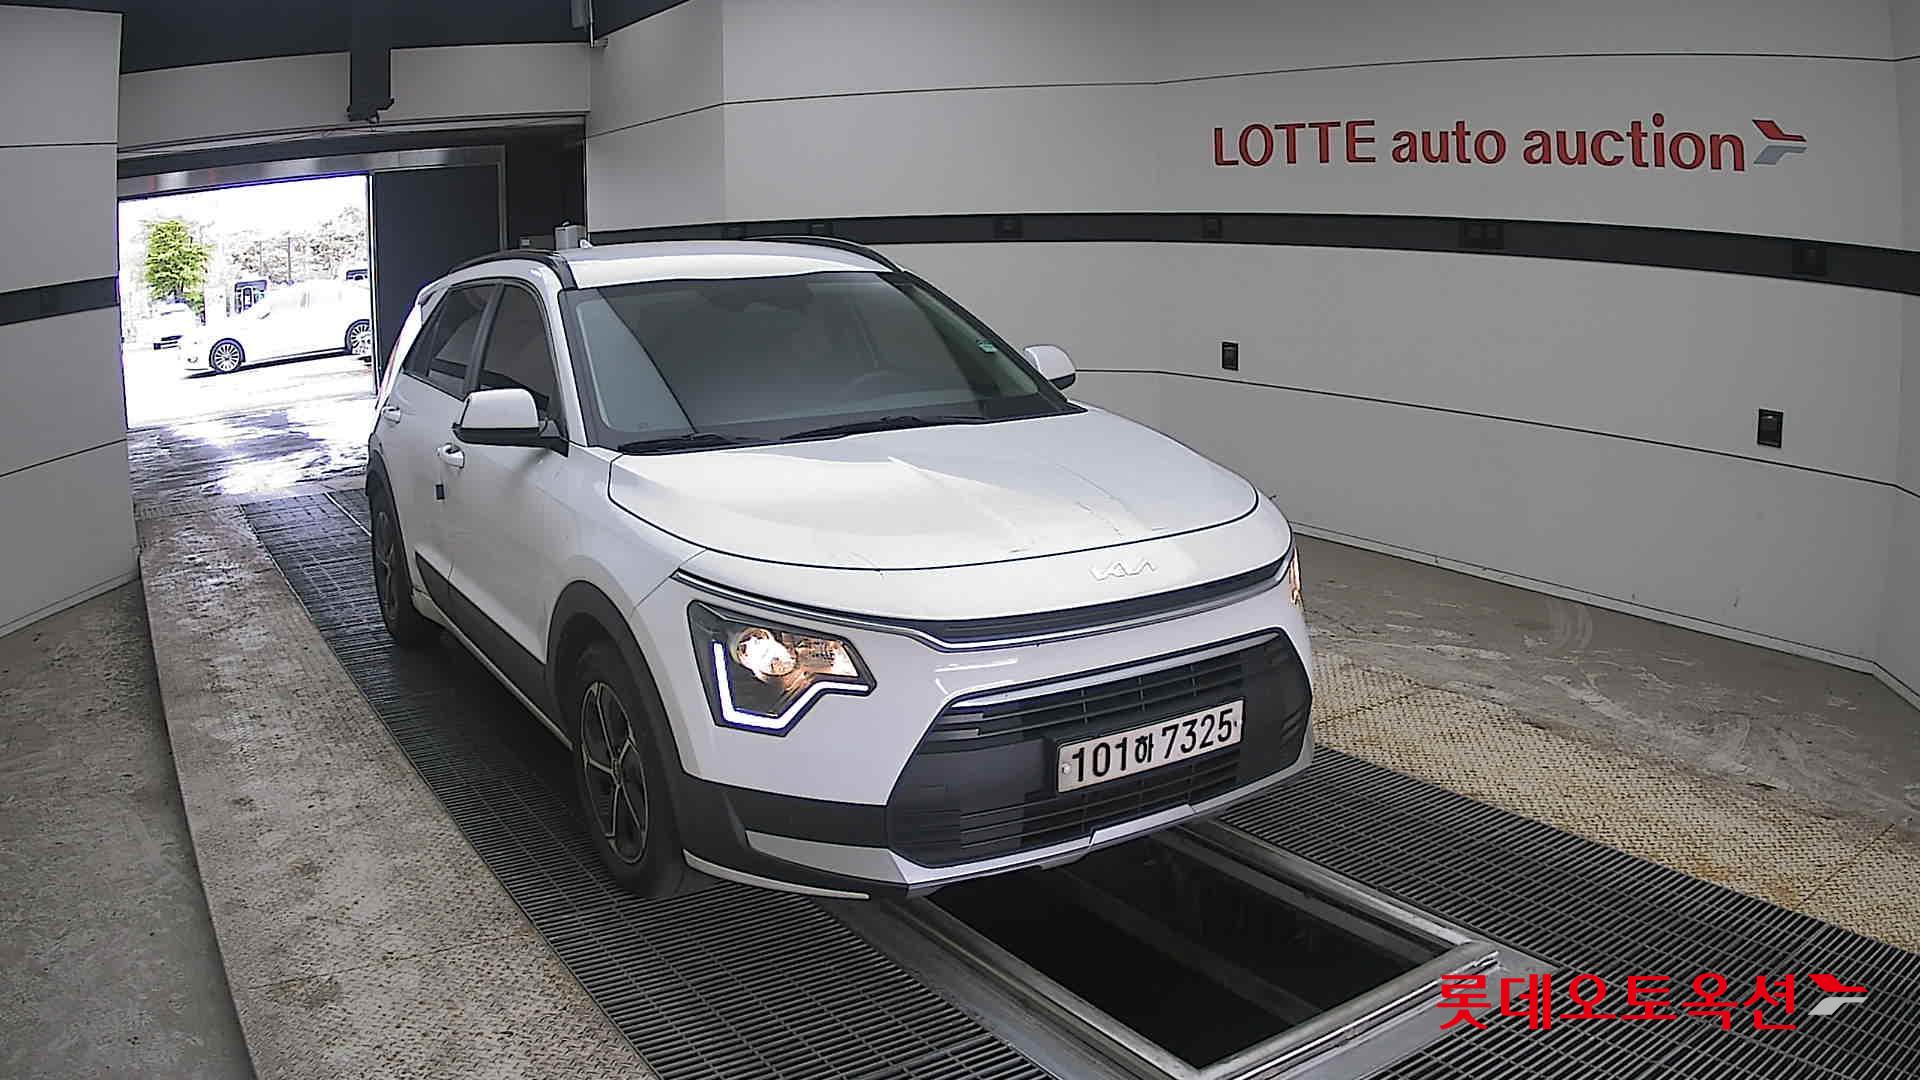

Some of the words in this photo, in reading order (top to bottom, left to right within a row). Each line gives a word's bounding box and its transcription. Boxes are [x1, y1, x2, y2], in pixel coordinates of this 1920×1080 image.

[1213, 119, 1377, 167] LOTTE
[1391, 119, 1507, 165] auto
[1523, 112, 1747, 171] auction
[1071, 732, 1155, 783] 101하
[1161, 707, 1234, 760] 7325
